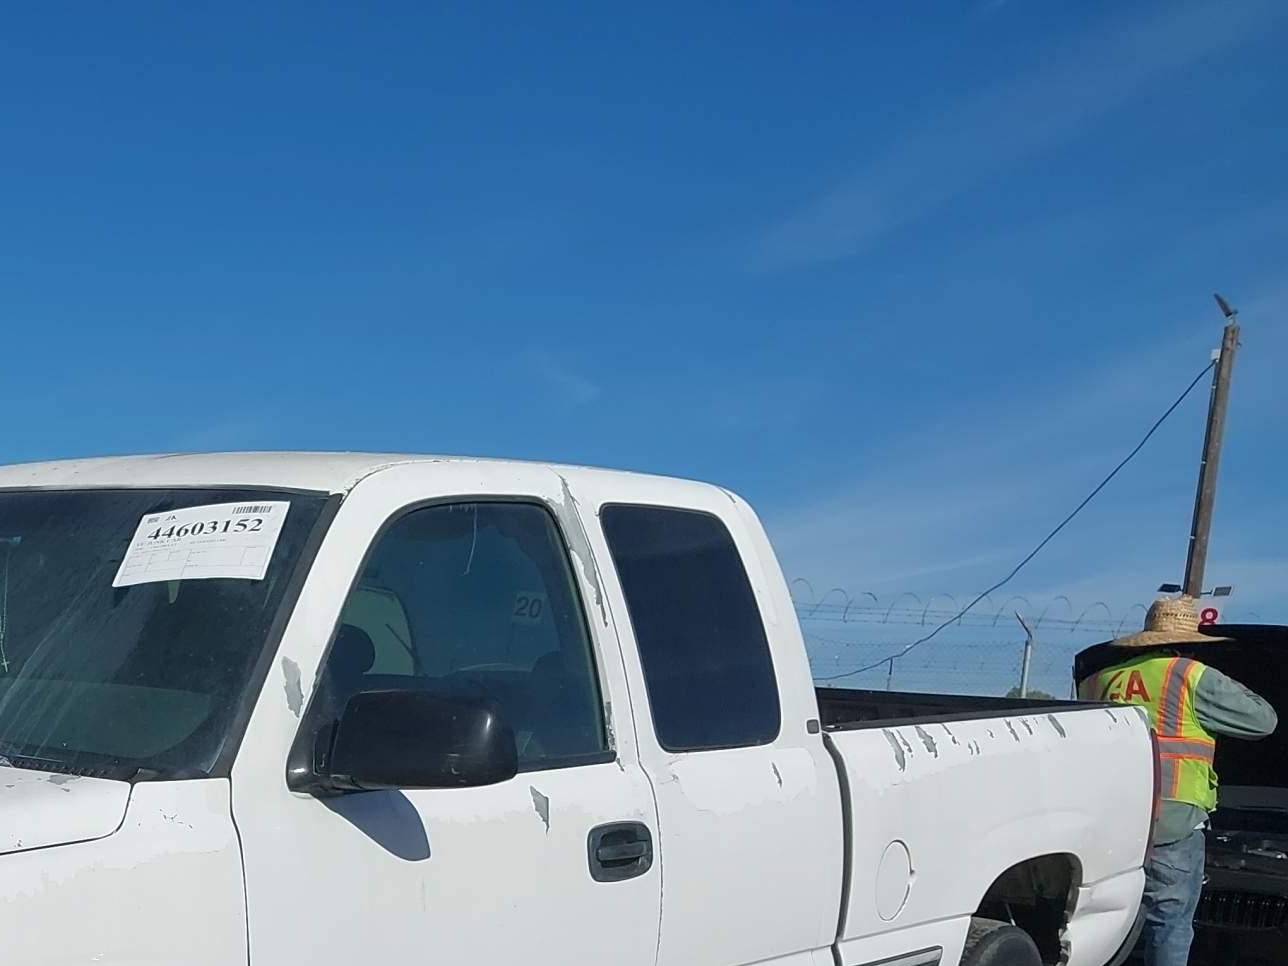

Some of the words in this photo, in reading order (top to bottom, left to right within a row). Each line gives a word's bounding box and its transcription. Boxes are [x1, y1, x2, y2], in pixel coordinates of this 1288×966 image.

[147, 518, 264, 540] 44603152
[514, 596, 542, 619] 20
[1199, 607, 1219, 625] 8
